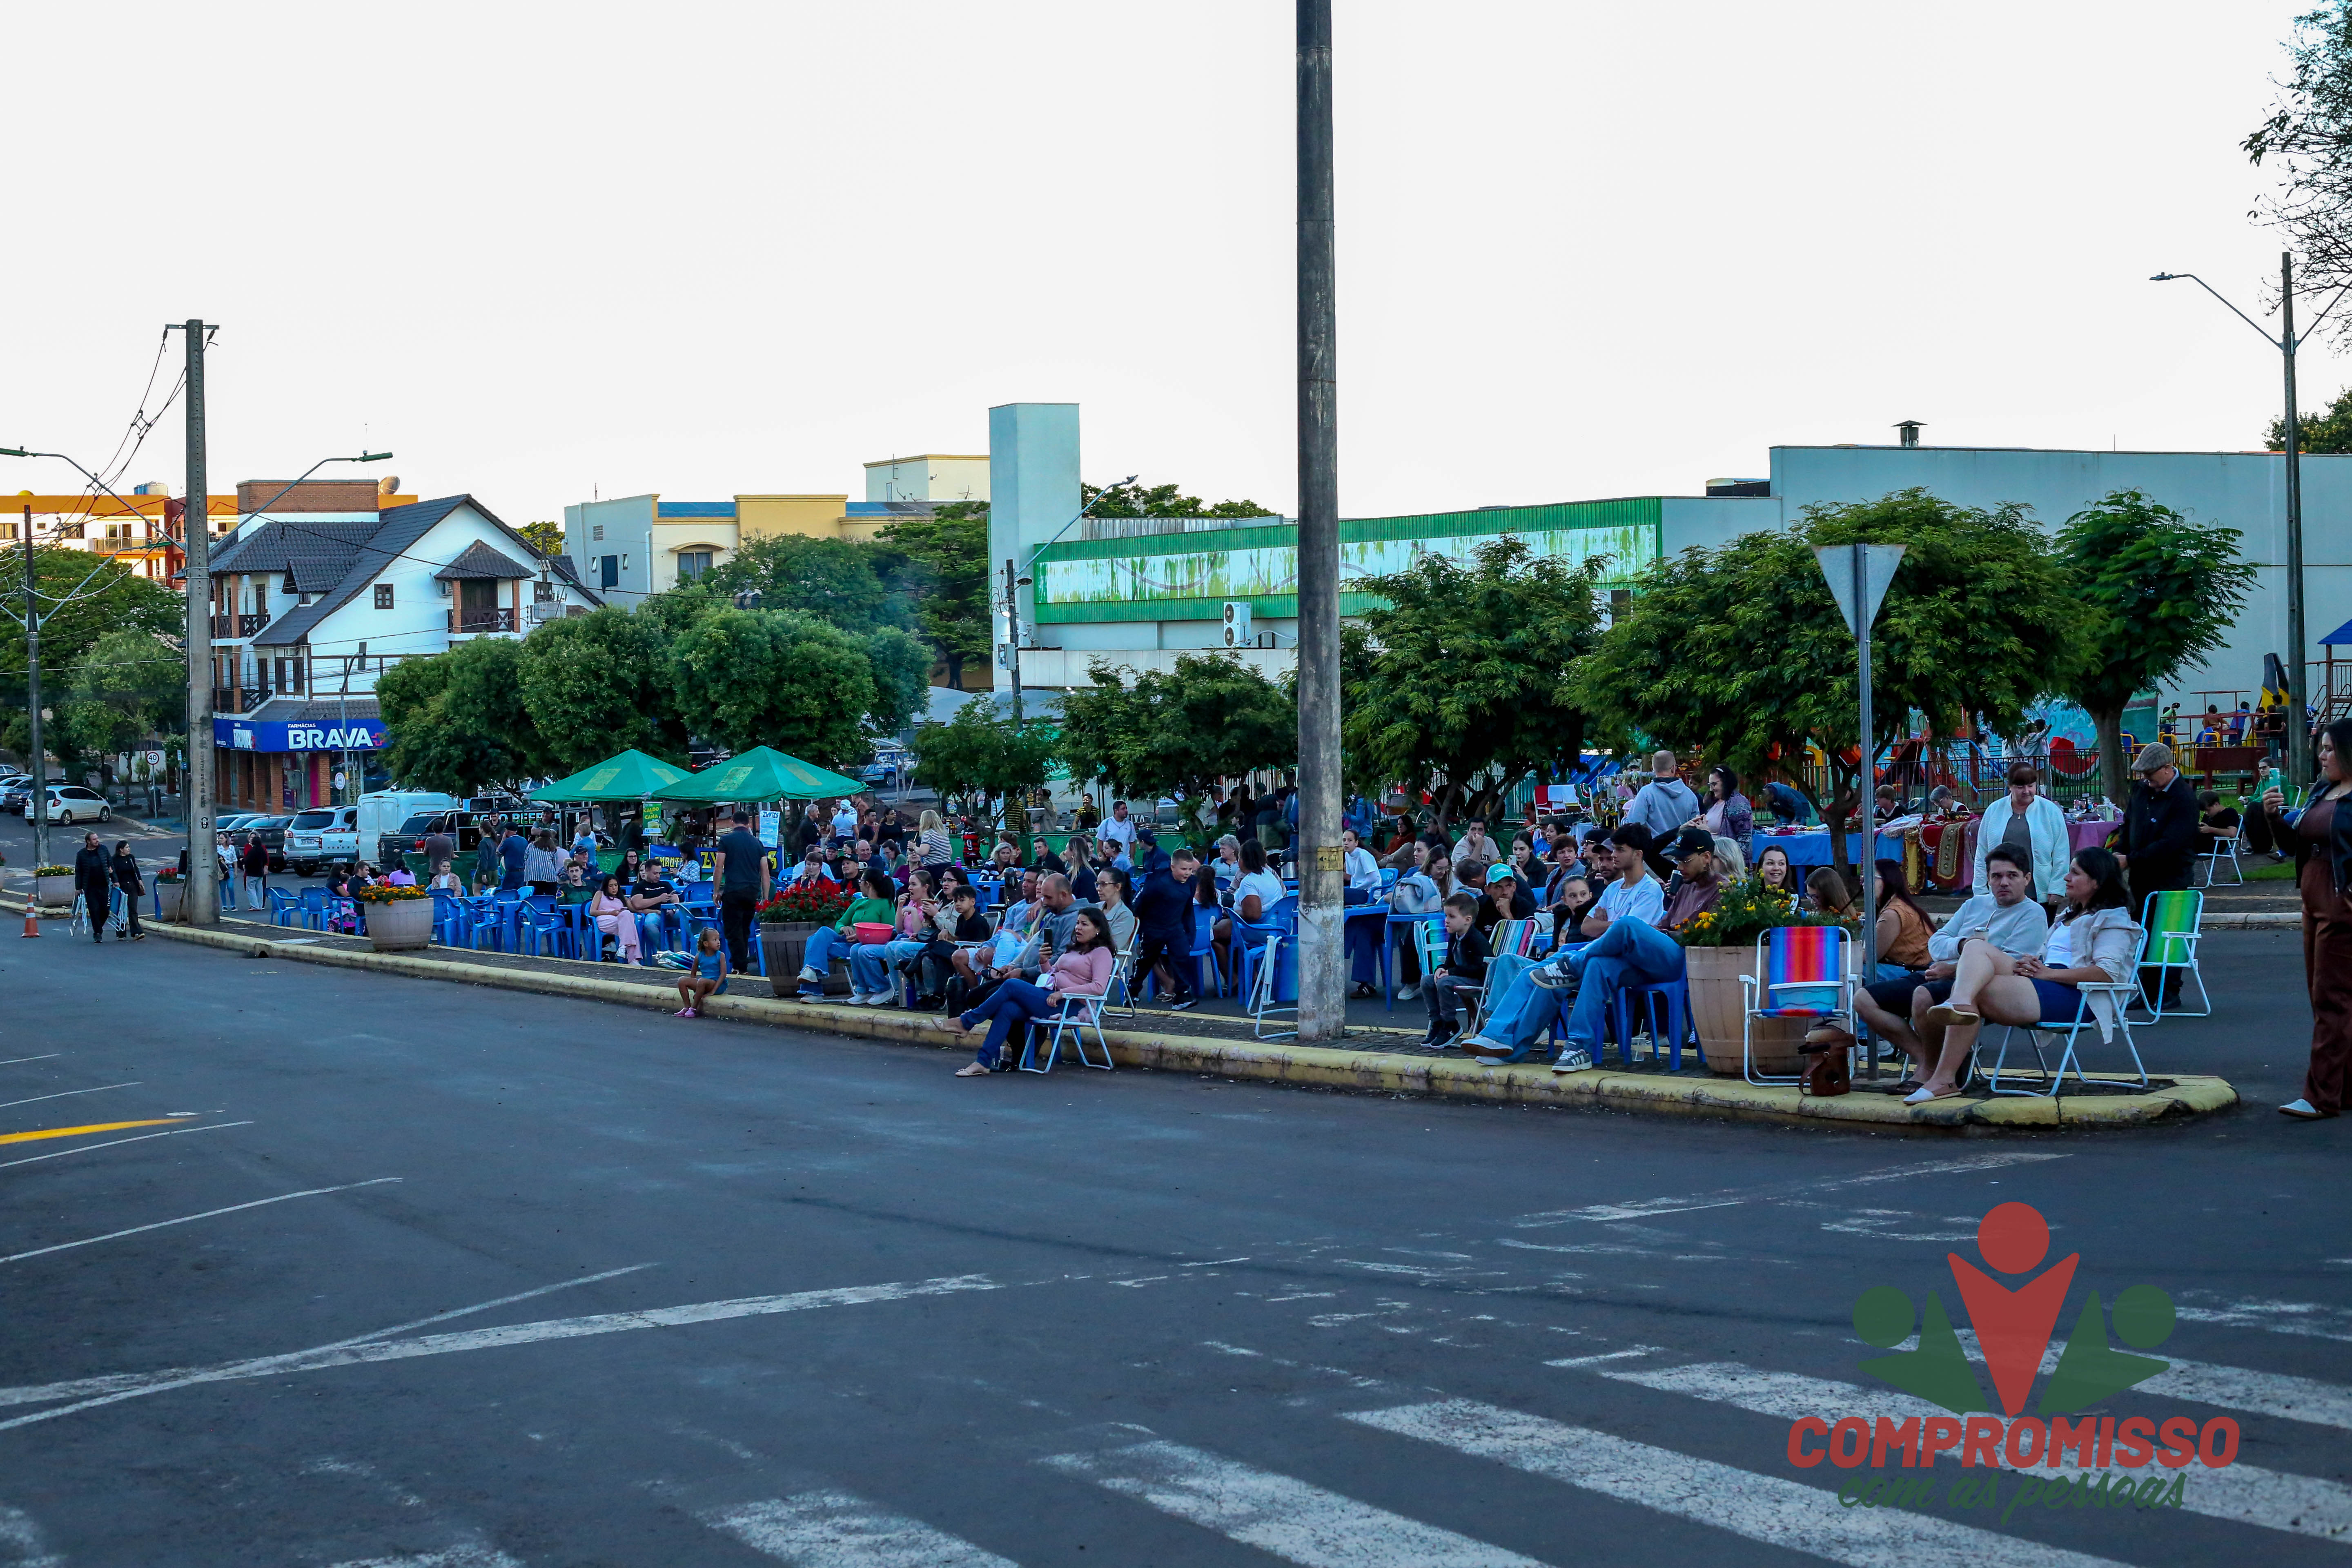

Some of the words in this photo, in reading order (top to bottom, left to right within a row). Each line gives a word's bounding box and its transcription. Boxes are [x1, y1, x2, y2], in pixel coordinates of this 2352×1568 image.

[233, 729, 253, 749] BRAVA
[288, 728, 373, 749] BRAVA
[471, 814, 508, 825] AGO
[966, 839, 973, 851] 9
